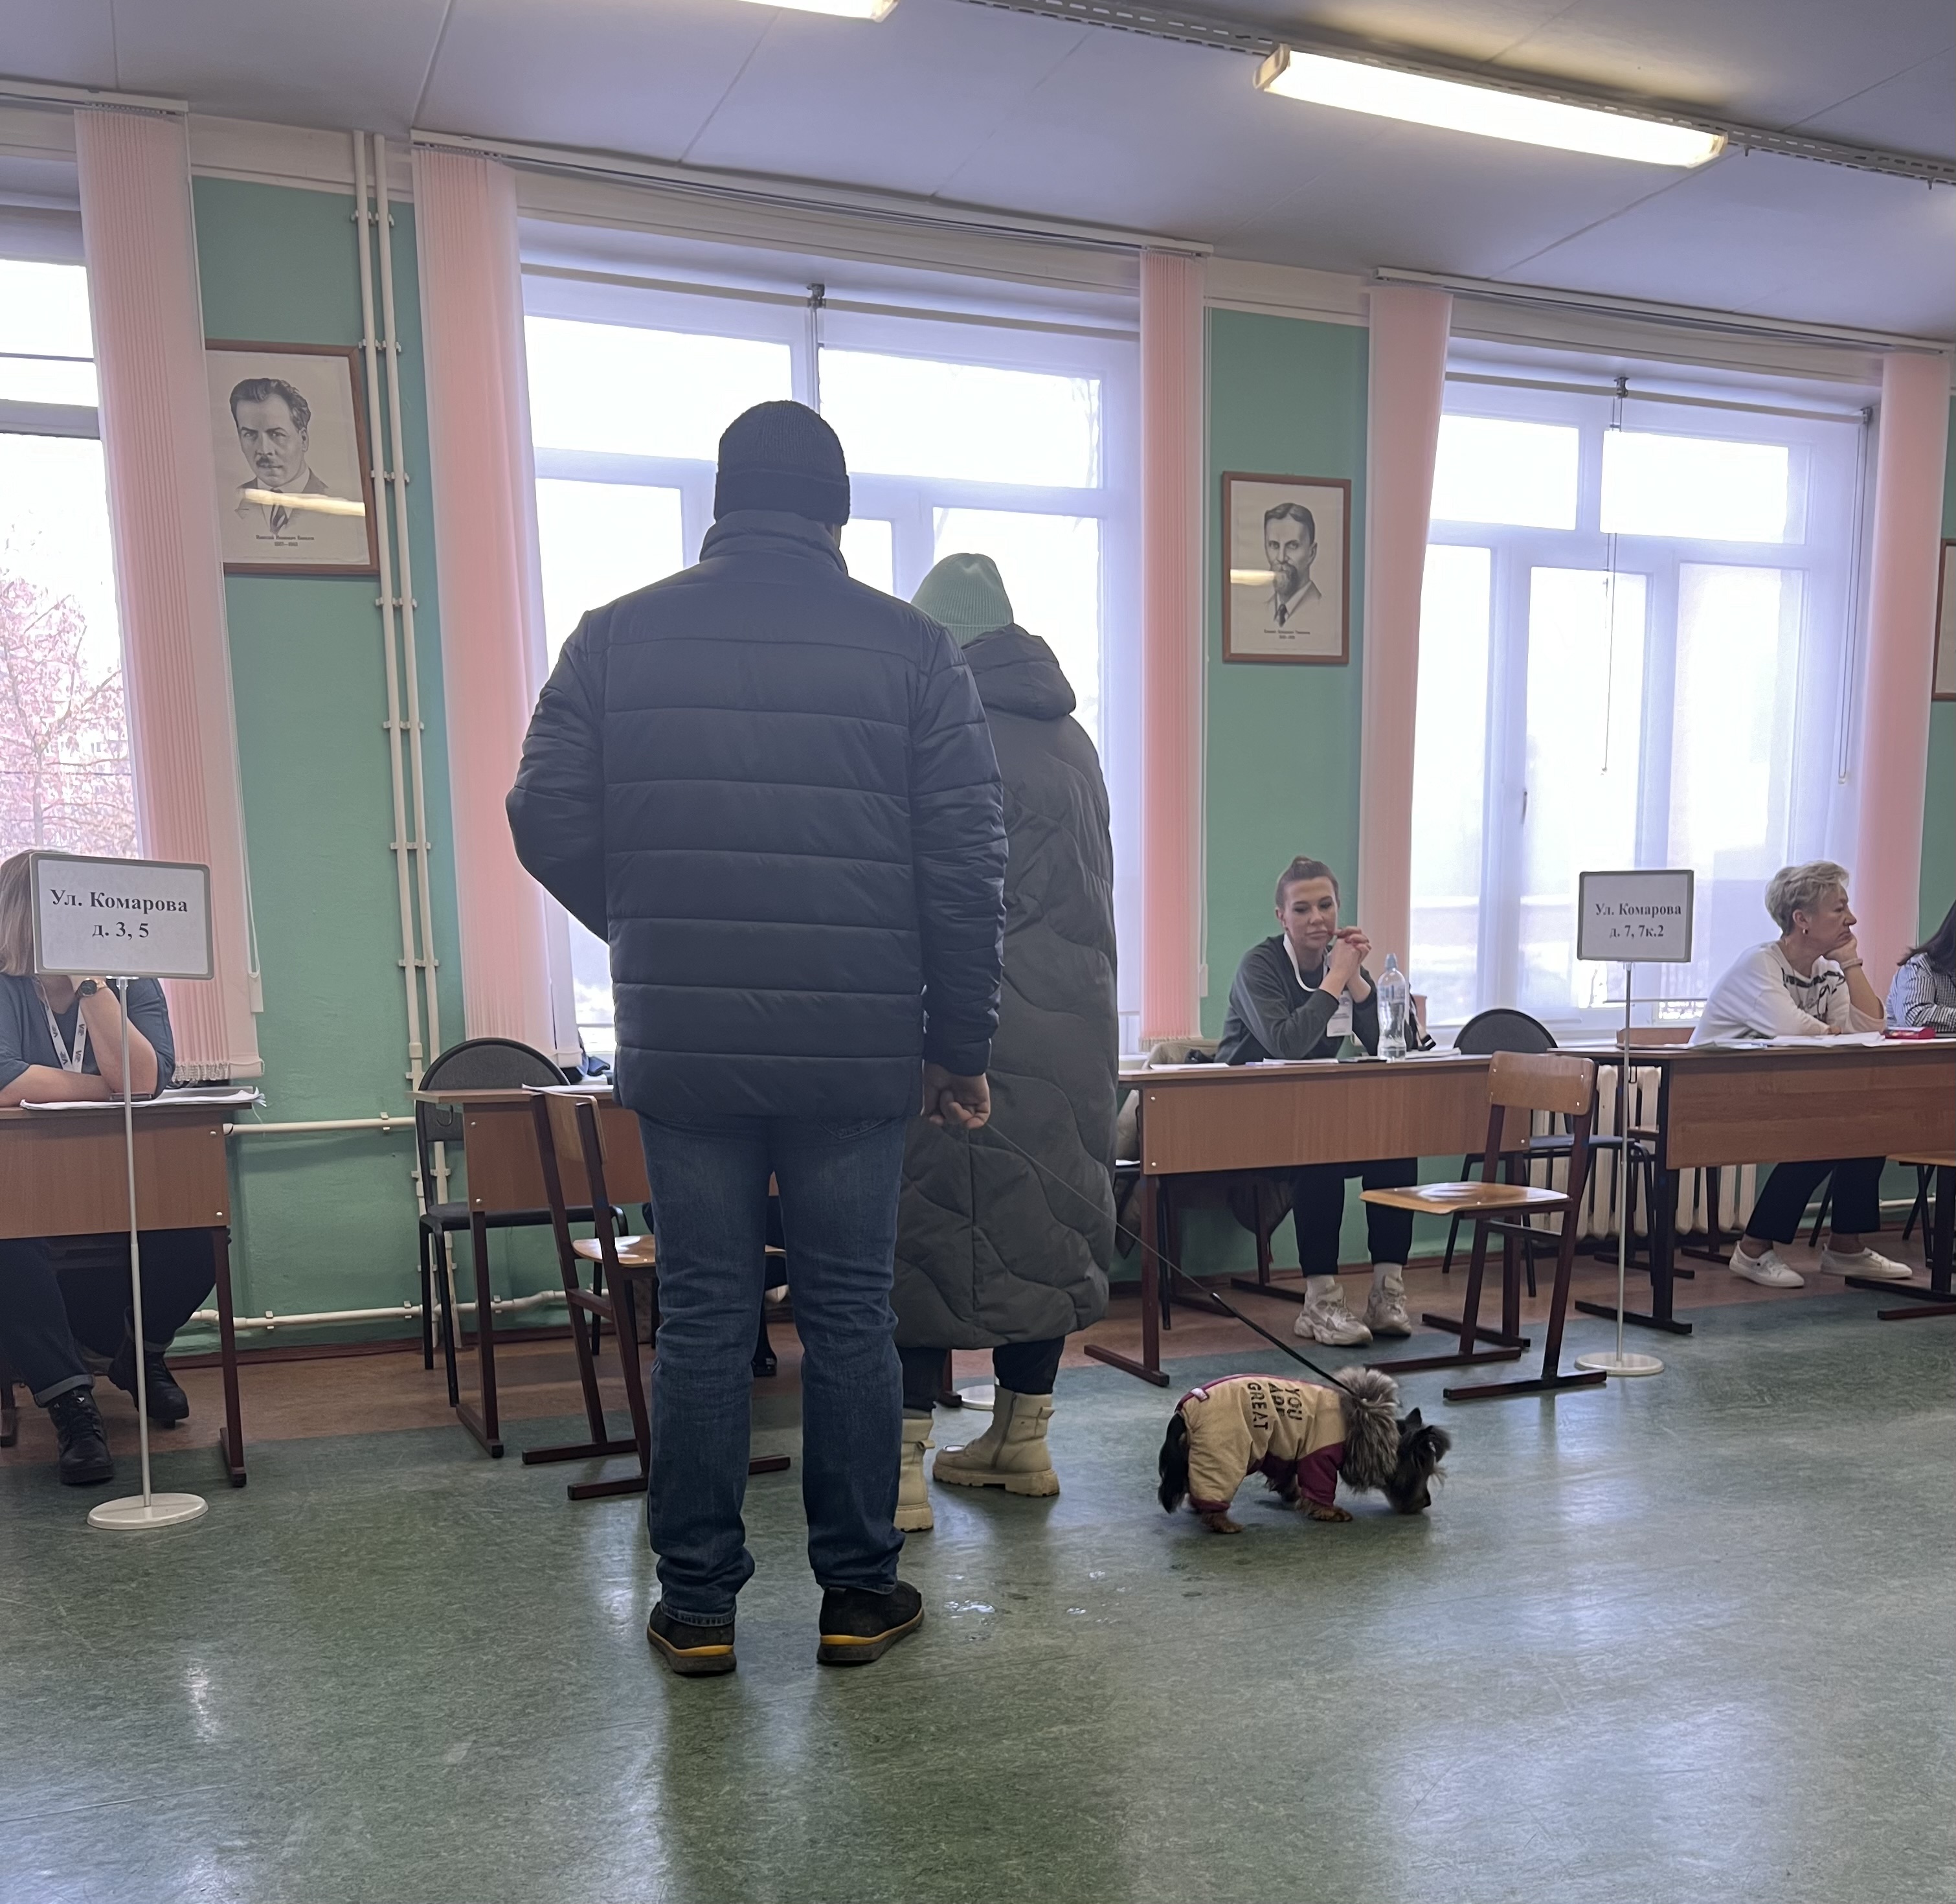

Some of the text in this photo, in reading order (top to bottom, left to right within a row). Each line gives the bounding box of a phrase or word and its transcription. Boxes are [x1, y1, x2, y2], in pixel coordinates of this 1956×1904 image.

[50, 889, 188, 914] Ул. Комарова
[1595, 903, 1681, 918] Ул. Комарова
[92, 922, 149, 940] д. 3, 5
[1609, 928, 1621, 938] д.
[1638, 924, 1664, 938] 7к.2
[1247, 1382, 1268, 1431] GREAT
[1285, 1388, 1303, 1421] YOU
